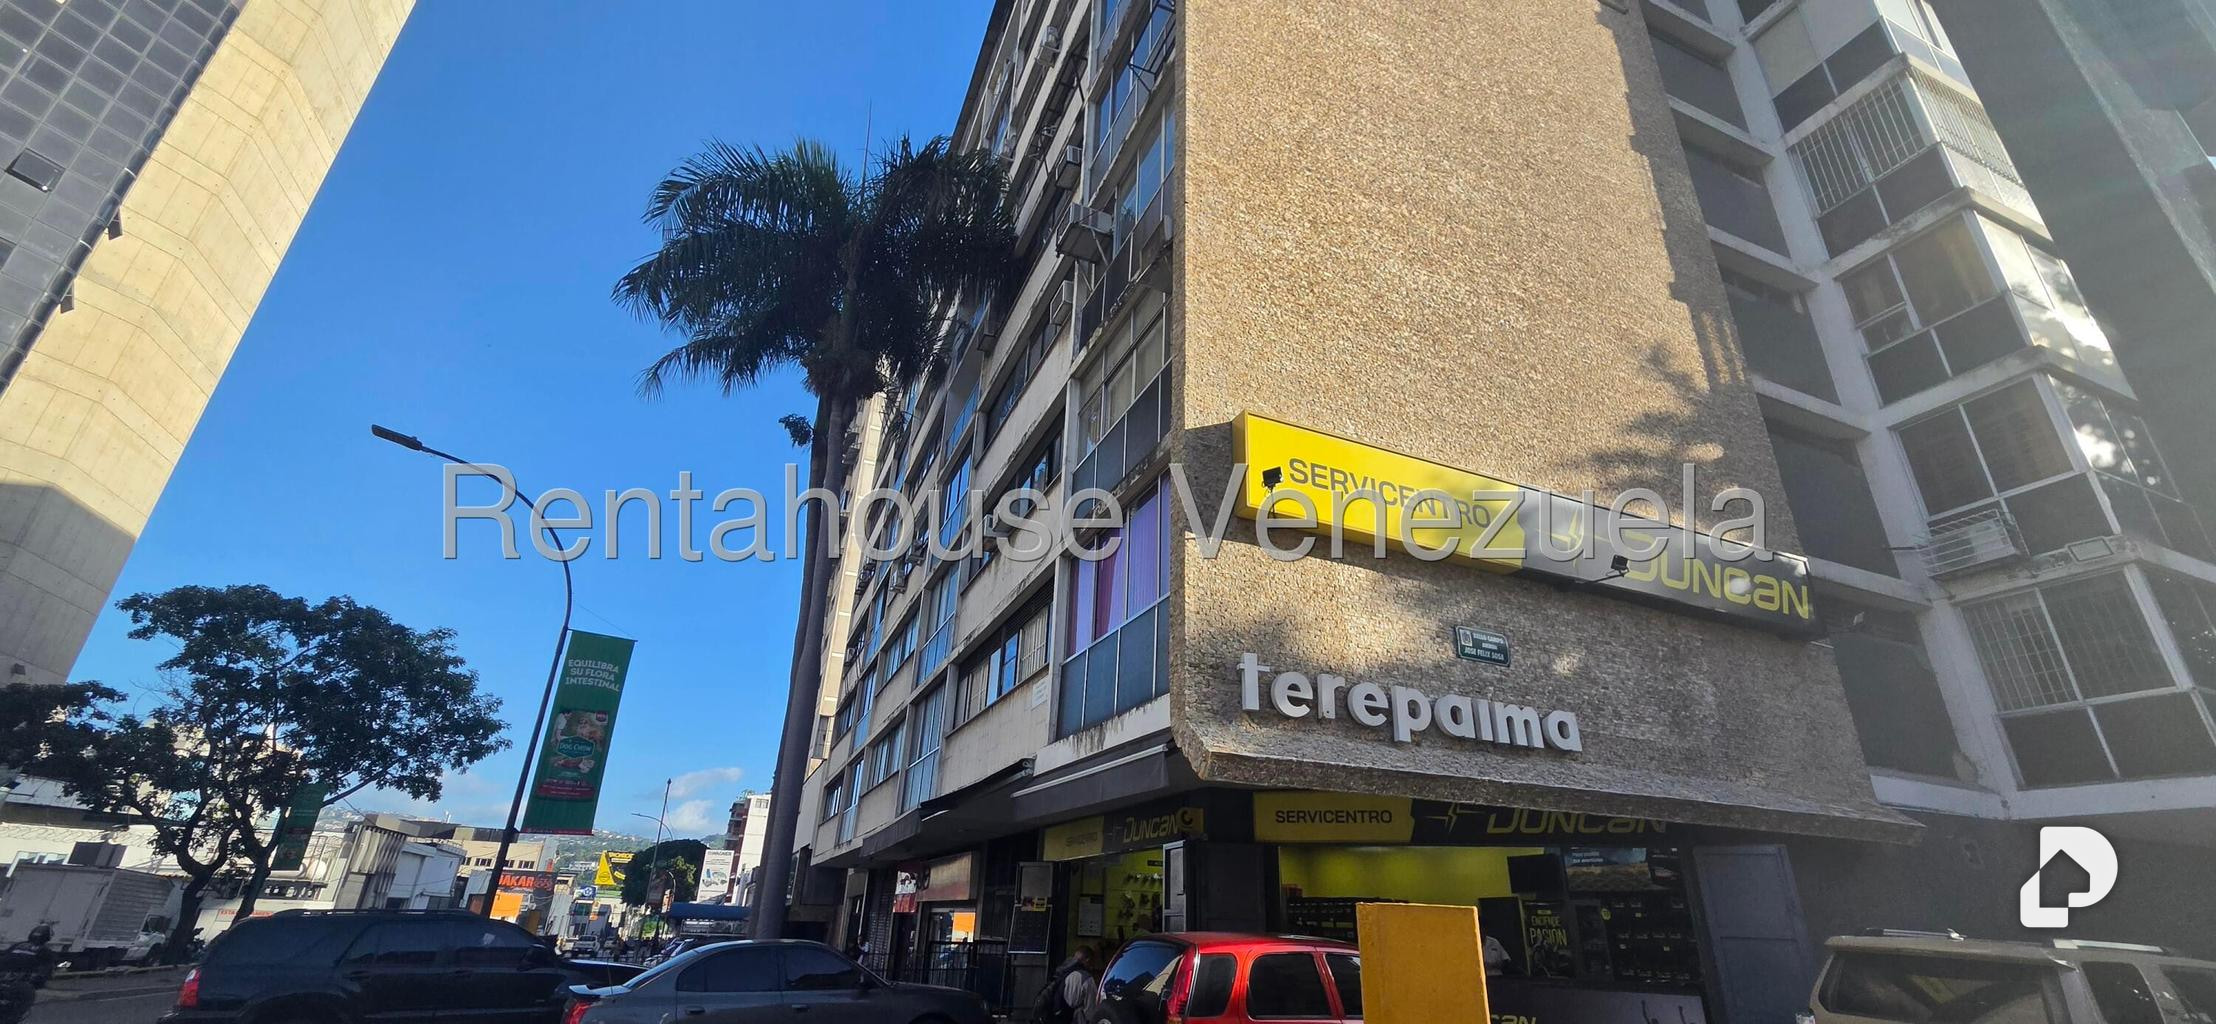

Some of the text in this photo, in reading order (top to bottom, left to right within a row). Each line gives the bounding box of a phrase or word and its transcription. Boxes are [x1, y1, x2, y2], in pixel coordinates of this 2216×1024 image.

[1289, 458, 1491, 529] SERVICENTRO
[568, 659, 619, 673] EQUILIBRA
[570, 668, 615, 681] SU FLORA
[565, 677, 620, 692] INTESTINAL
[1236, 652, 1583, 752] terepaima
[1275, 809, 1393, 824] SERVICENTRO
